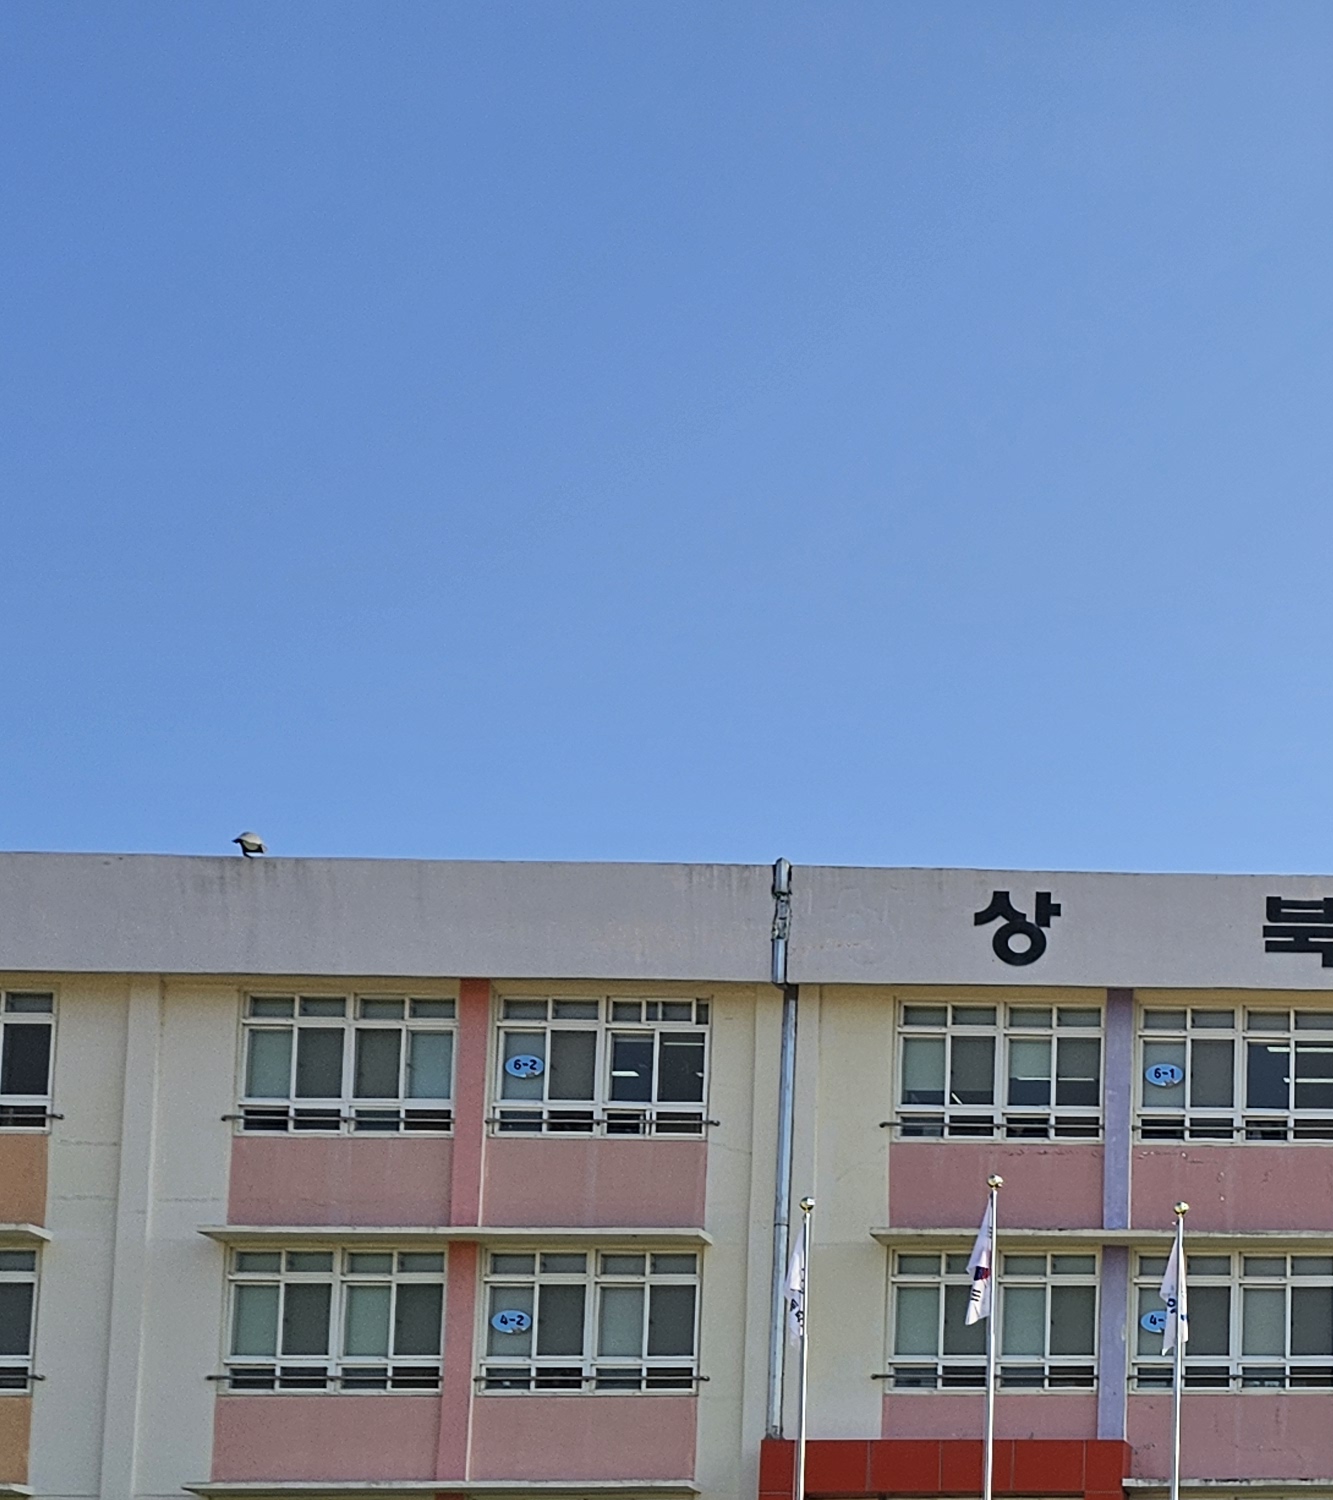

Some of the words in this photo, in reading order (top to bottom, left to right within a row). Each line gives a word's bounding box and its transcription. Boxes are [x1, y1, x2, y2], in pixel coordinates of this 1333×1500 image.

[513, 1059, 537, 1070] 6-2
[1154, 1067, 1175, 1079] 6-1
[500, 1314, 524, 1326] 4-2
[1149, 1314, 1164, 1326] 4-
